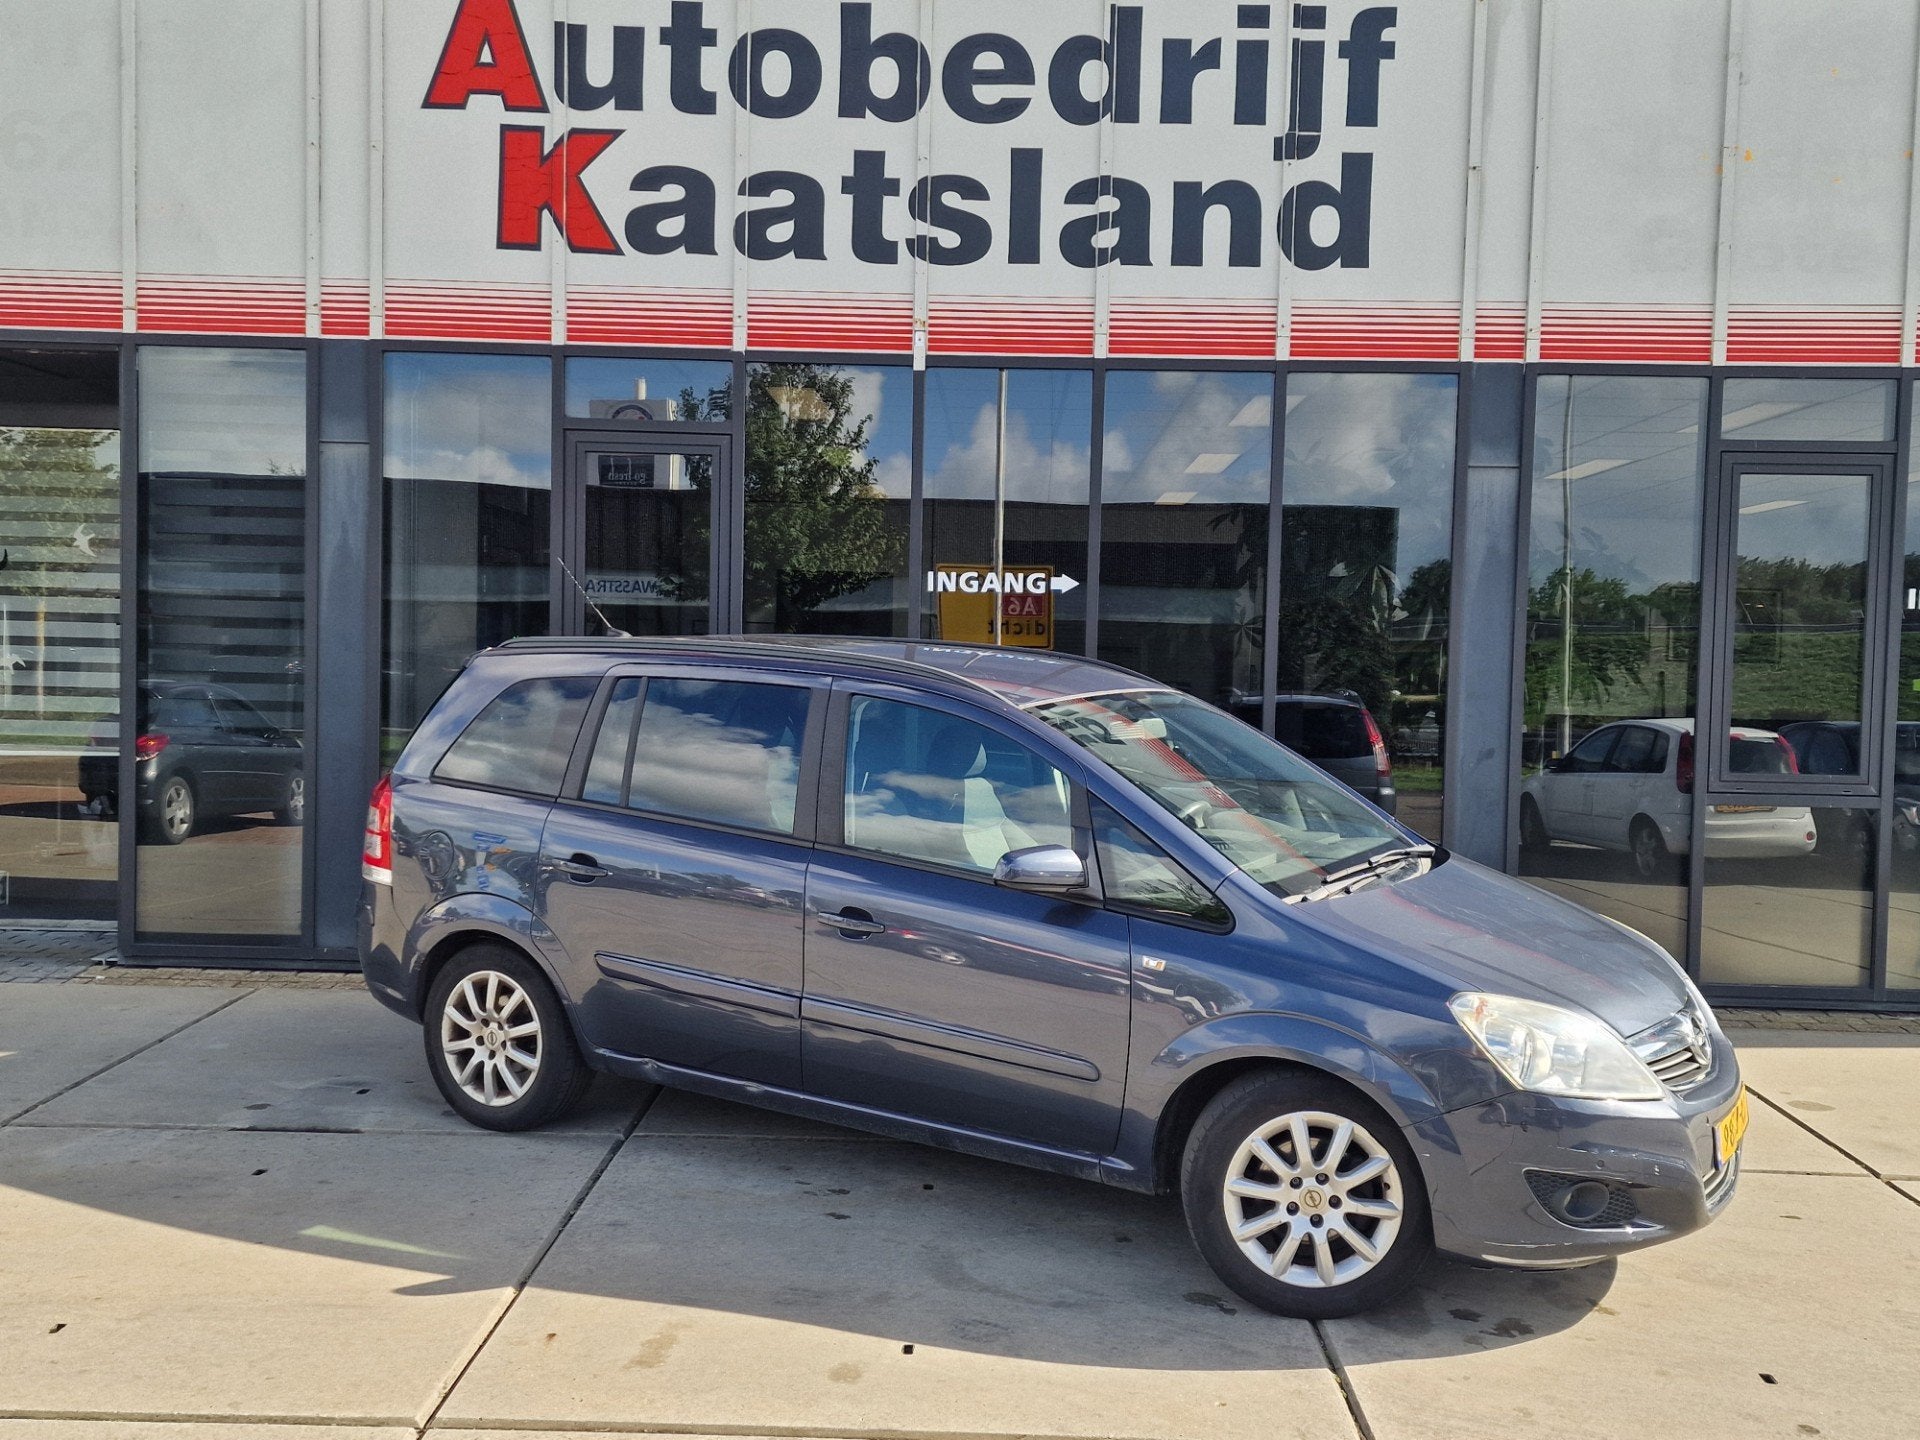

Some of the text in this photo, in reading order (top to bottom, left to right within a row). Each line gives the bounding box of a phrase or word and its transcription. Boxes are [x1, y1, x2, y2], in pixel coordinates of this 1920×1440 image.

[421, 0, 1398, 162] Autobedrijf
[496, 123, 1374, 271] Kaatsland
[927, 571, 1046, 594] INGANG
